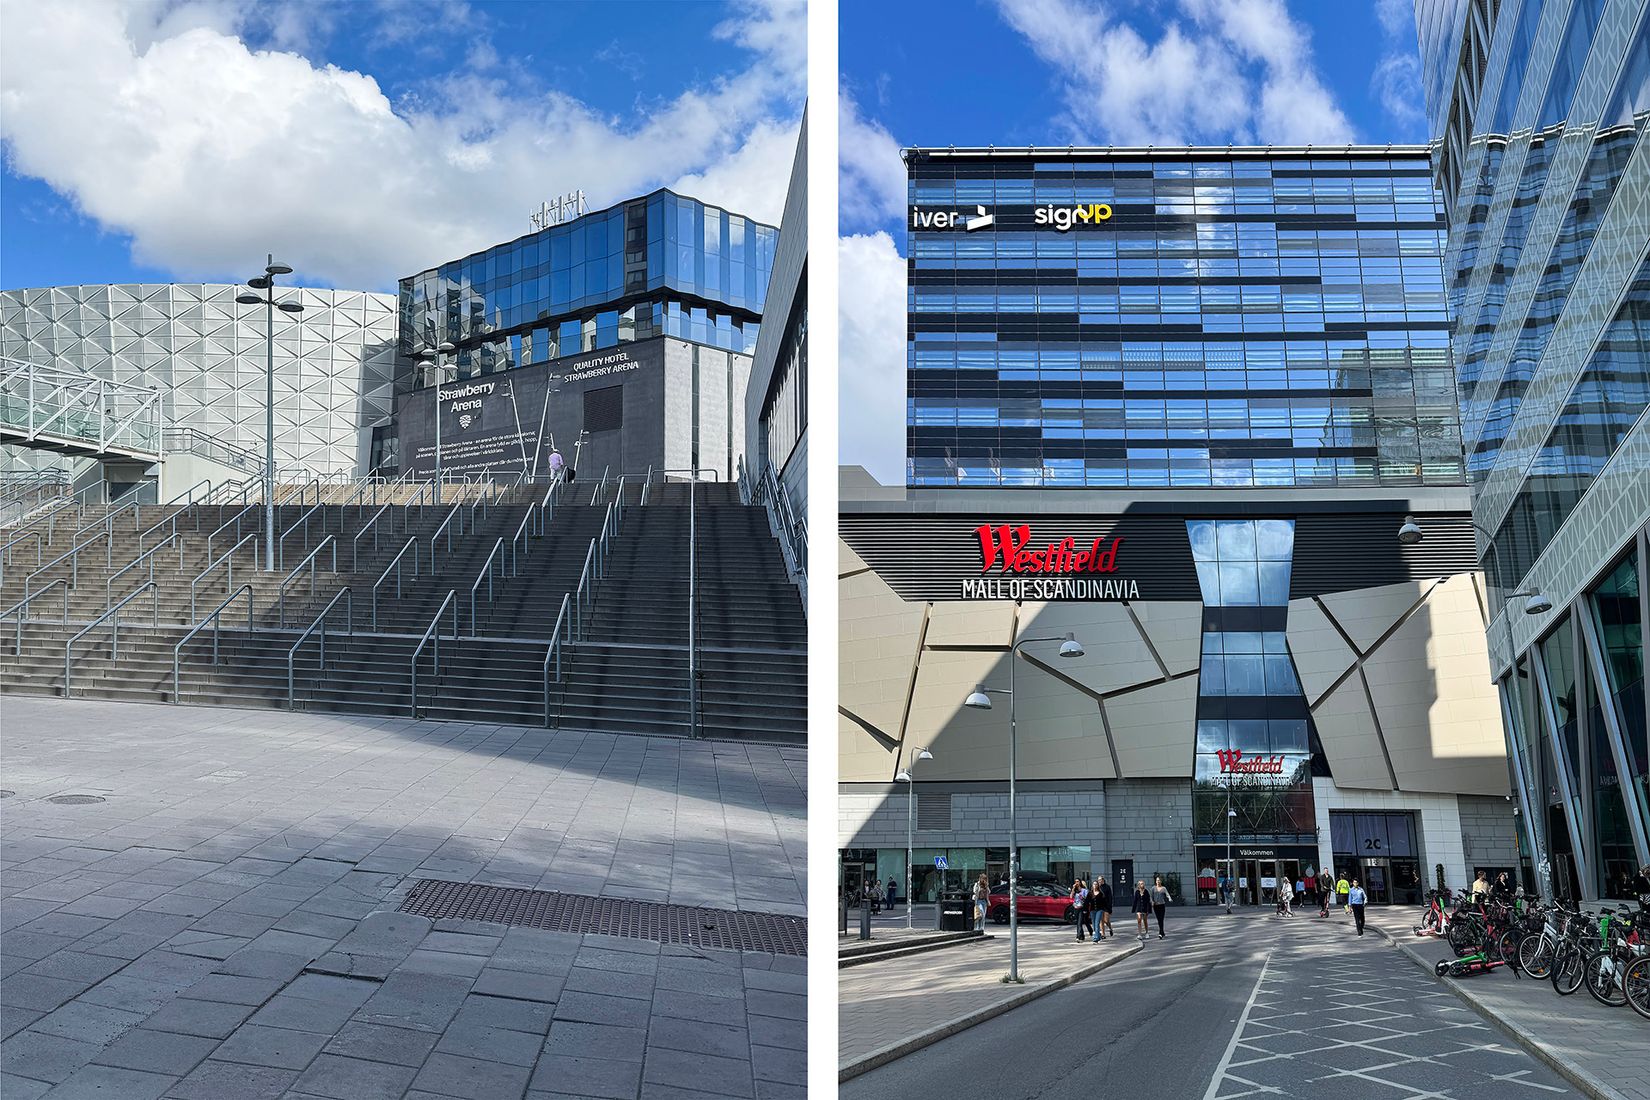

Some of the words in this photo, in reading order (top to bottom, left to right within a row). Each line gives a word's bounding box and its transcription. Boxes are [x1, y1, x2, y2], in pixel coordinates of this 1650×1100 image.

[913, 206, 958, 228] iver
[564, 365, 612, 383] STRAWBERRY
[612, 361, 639, 373] ARENA
[573, 359, 603, 372] QUALITY
[605, 352, 629, 364] HOTEL
[438, 382, 495, 401] Strawberry
[450, 399, 482, 413] Arena
[974, 523, 1125, 574] Westfield
[962, 579, 1006, 600] MALL
[1009, 579, 1029, 600] OF
[1033, 579, 1141, 600] SCANDINAVIA
[1215, 748, 1286, 775] Westfield
[1242, 776, 1294, 787] SCANDINAVIA
[1364, 838, 1382, 850] 2C
